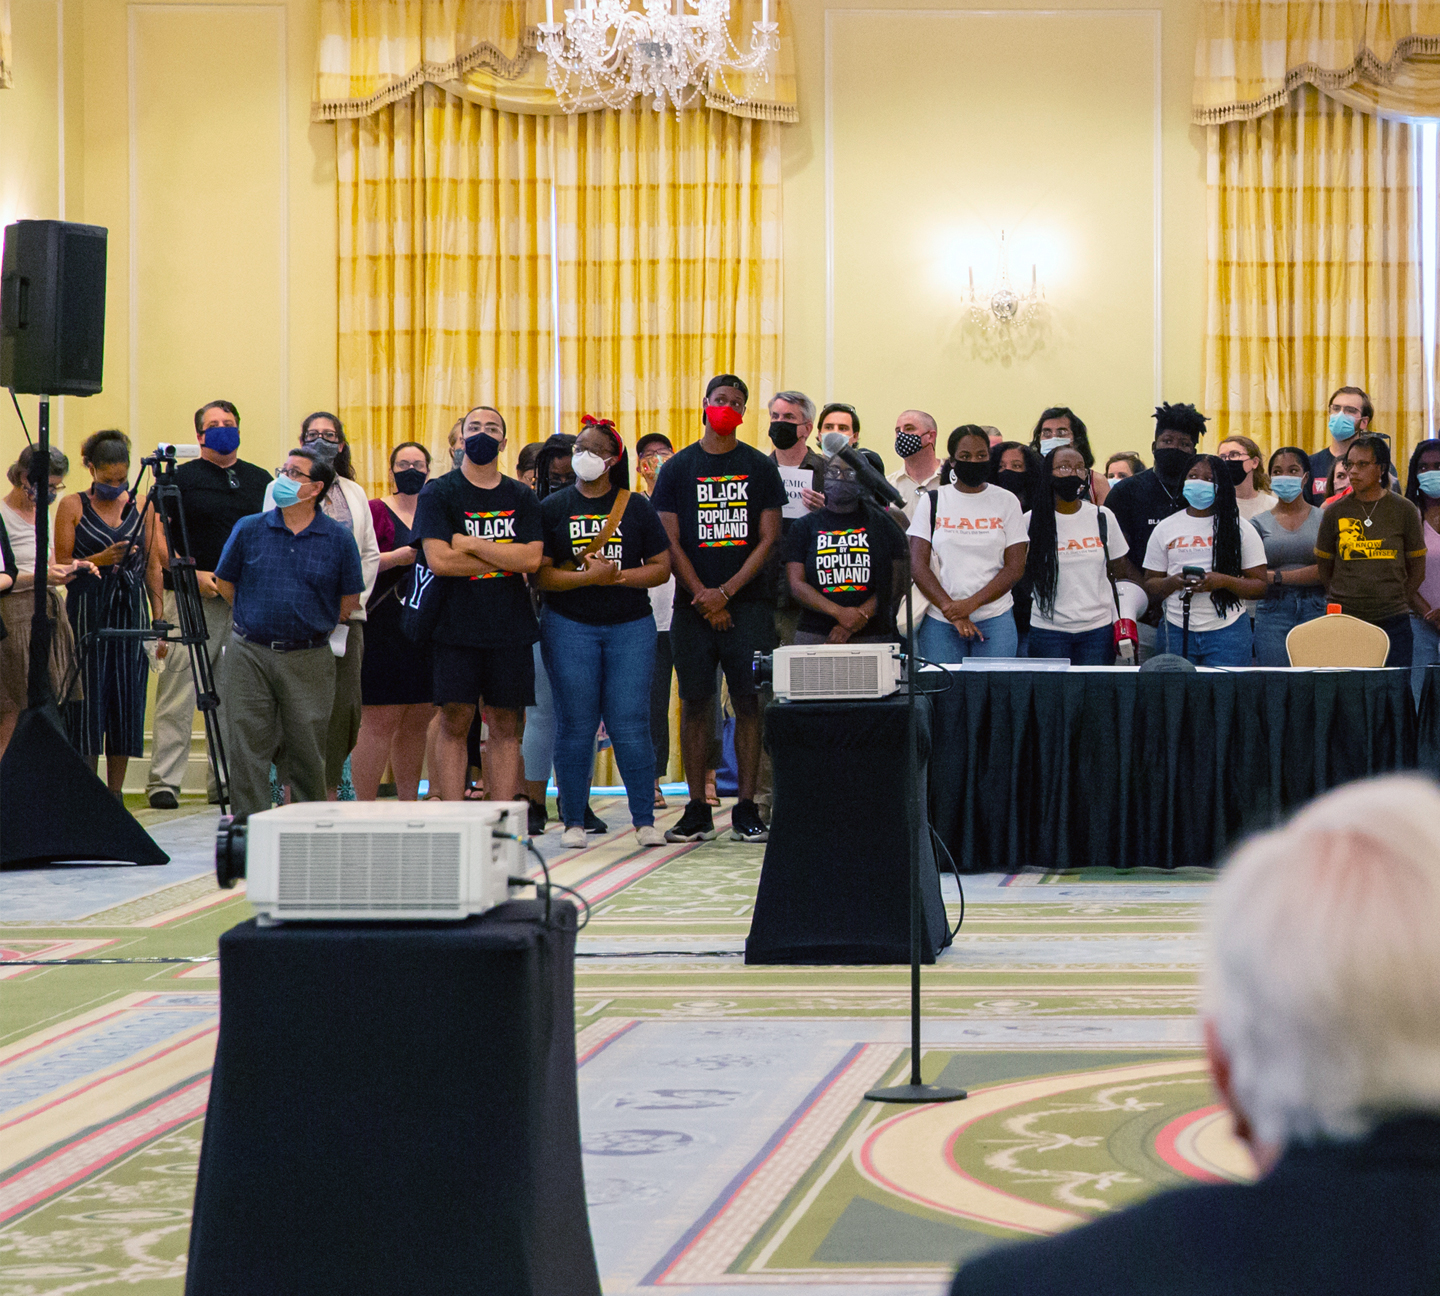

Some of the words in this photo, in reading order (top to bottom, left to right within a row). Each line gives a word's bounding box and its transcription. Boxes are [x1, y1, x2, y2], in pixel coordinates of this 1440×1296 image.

[698, 482, 749, 502] BLACK
[699, 508, 748, 524] POPULAR
[465, 518, 517, 539] BLACK
[699, 522, 749, 539] DEMAND
[818, 533, 870, 550] BLACK
[817, 553, 871, 569] POPULAR
[818, 567, 871, 586] DEMAND
